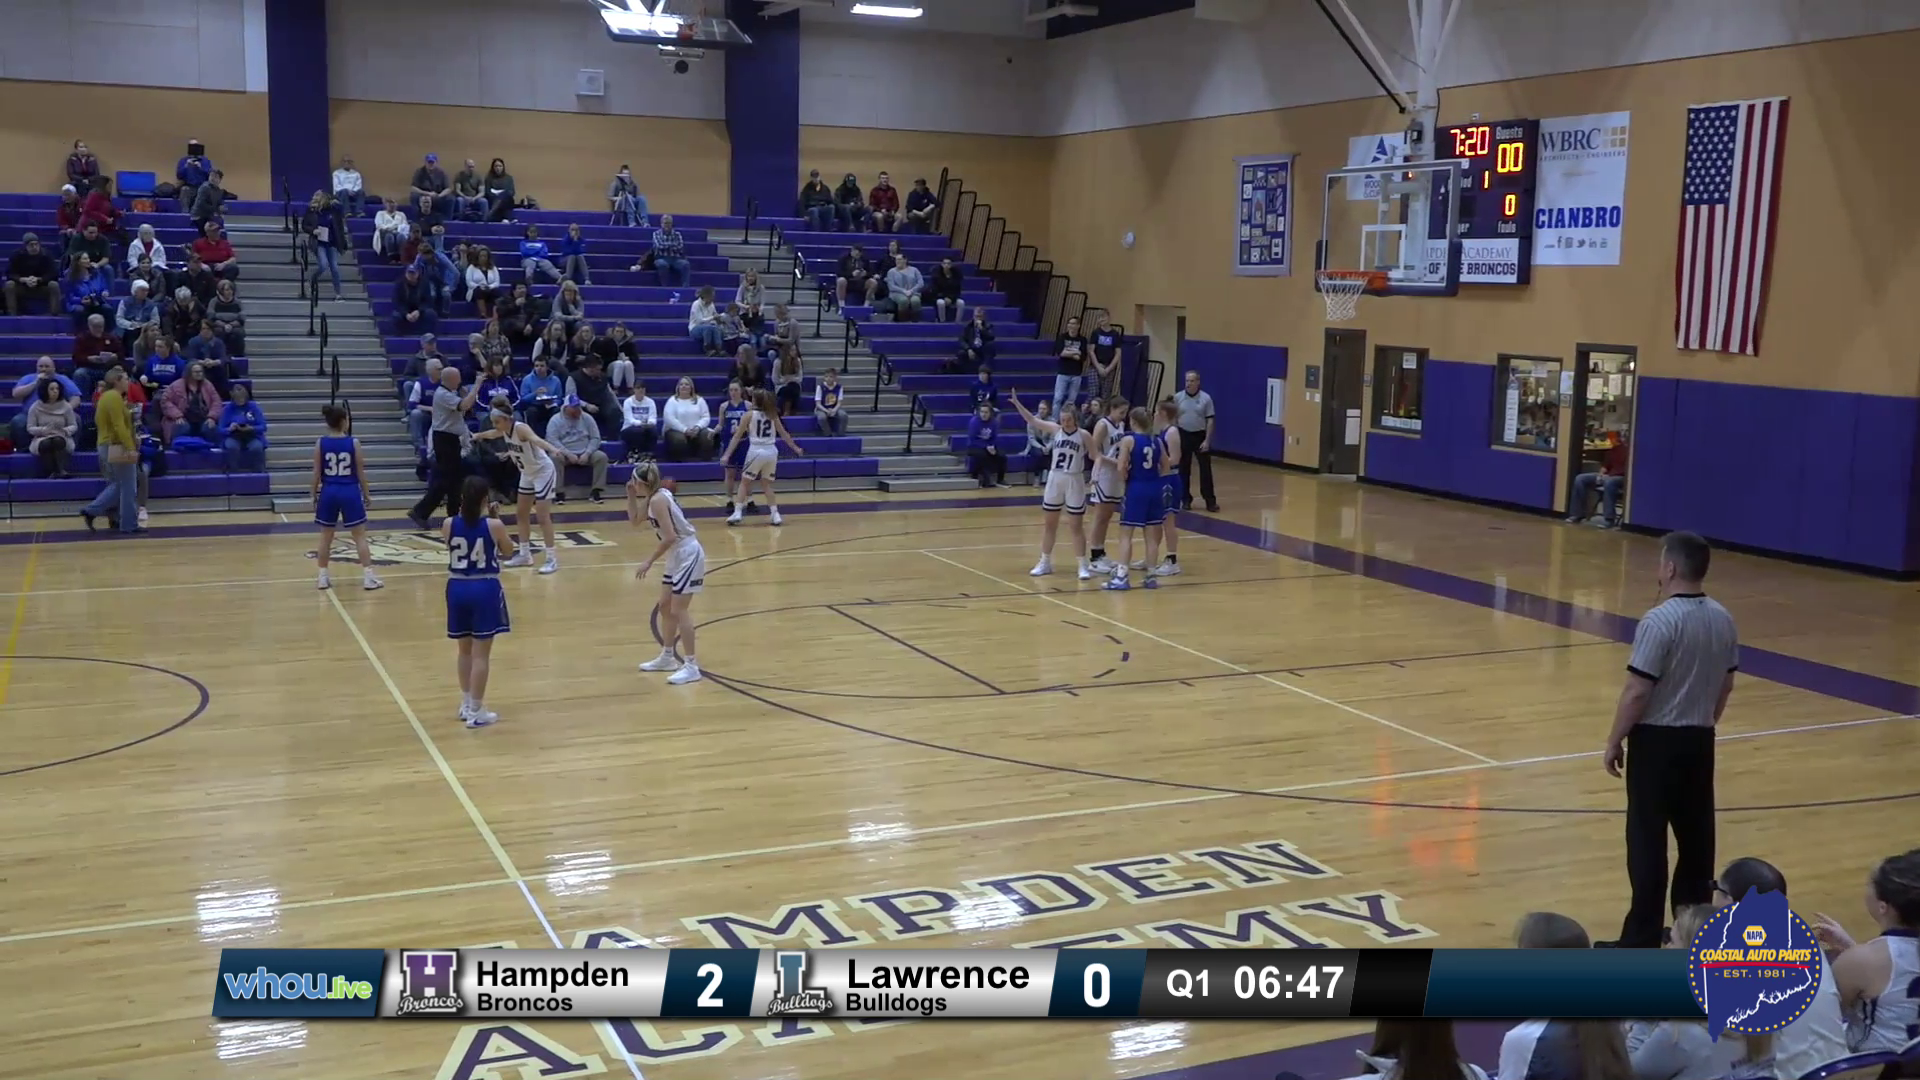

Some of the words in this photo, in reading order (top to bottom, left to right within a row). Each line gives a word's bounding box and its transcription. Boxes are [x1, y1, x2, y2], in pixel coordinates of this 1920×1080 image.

[1450, 127, 1490, 156] 7:20
[1541, 128, 1602, 152] WBRC
[1497, 143, 1524, 173] 00
[1484, 170, 1490, 189] 1
[1505, 195, 1516, 216] 0
[1535, 206, 1622, 229] CIANBRO
[1428, 263, 1441, 275] OF
[1467, 263, 1516, 275] BRONCOS
[757, 419, 772, 438] 12
[325, 452, 351, 476] 32
[1055, 452, 1075, 470] 21
[1143, 446, 1154, 470] 3
[451, 537, 487, 569] 24
